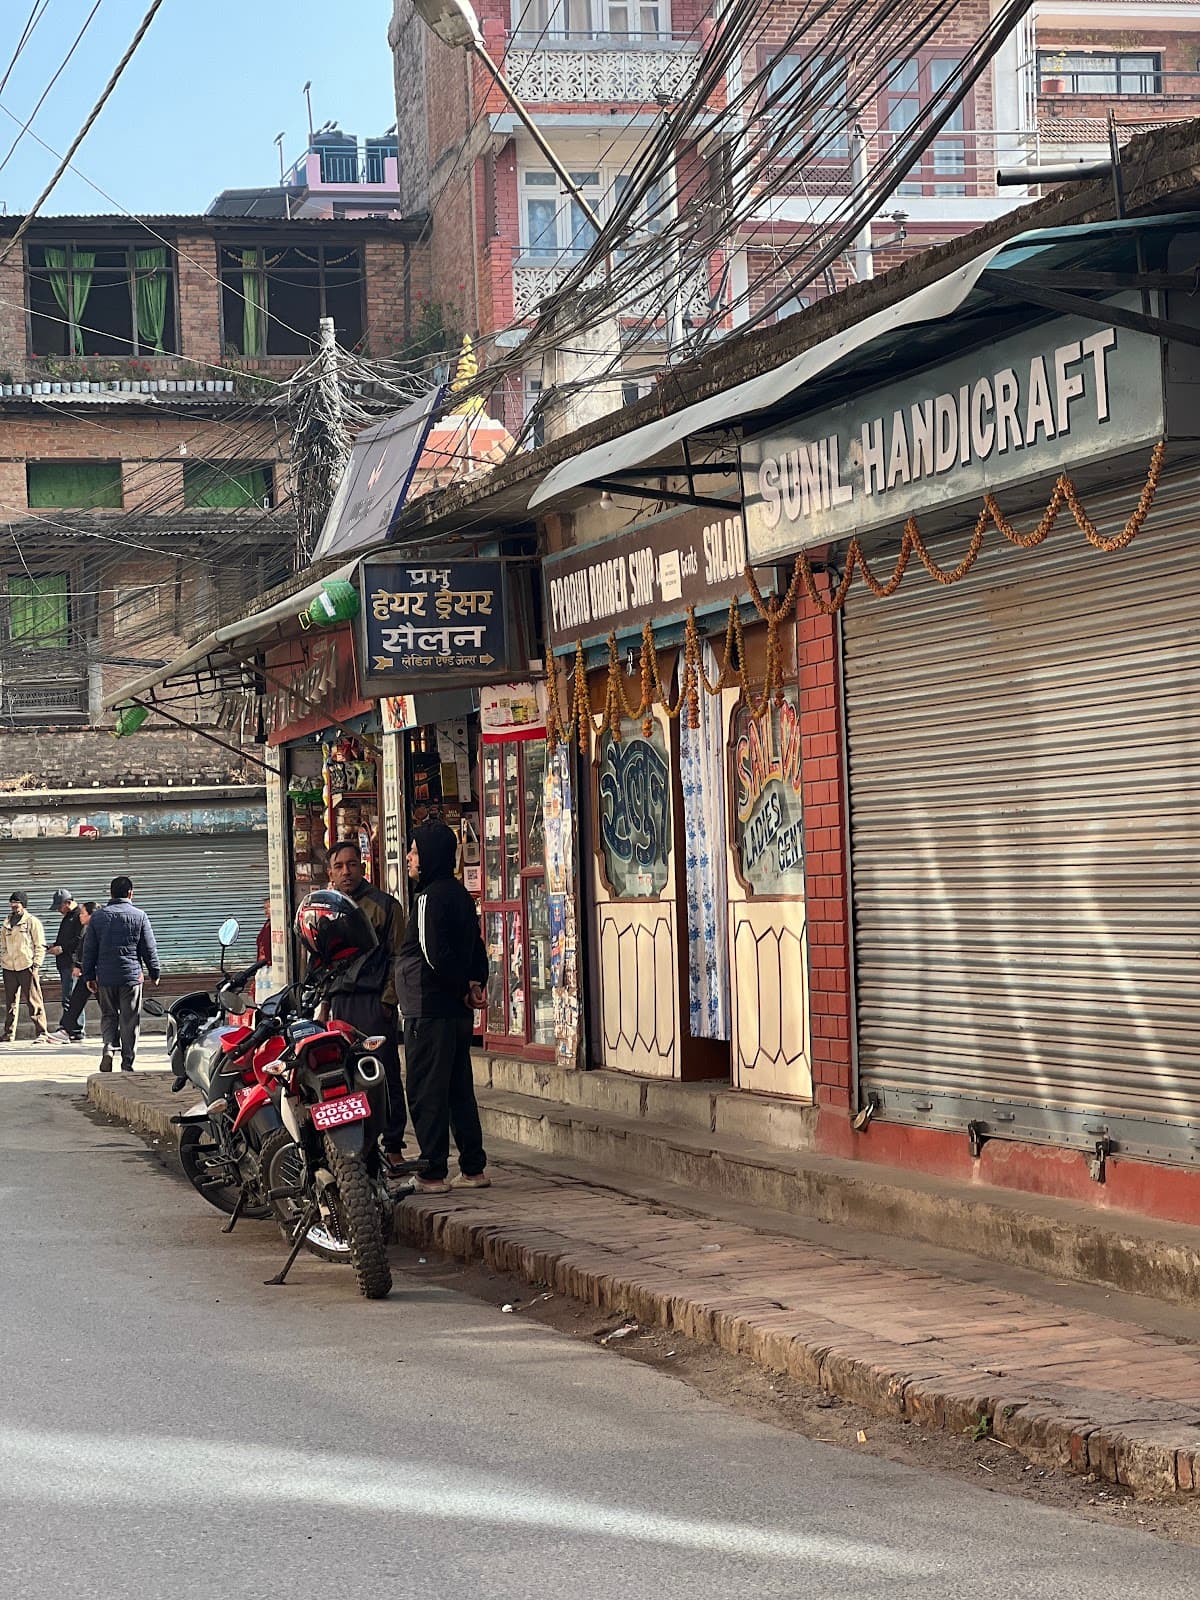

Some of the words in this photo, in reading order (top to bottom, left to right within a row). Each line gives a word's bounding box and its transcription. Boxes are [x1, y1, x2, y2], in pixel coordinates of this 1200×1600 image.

[759, 434, 853, 528] SUNIL
[861, 328, 1117, 495] HANDICRAFT
[371, 588, 428, 620] हेयर
[406, 569, 452, 588] प्रभु
[589, 556, 629, 620] BARBER
[628, 547, 655, 609] SHOP
[381, 621, 487, 656] सैलुन
[743, 791, 782, 871] LADIES
